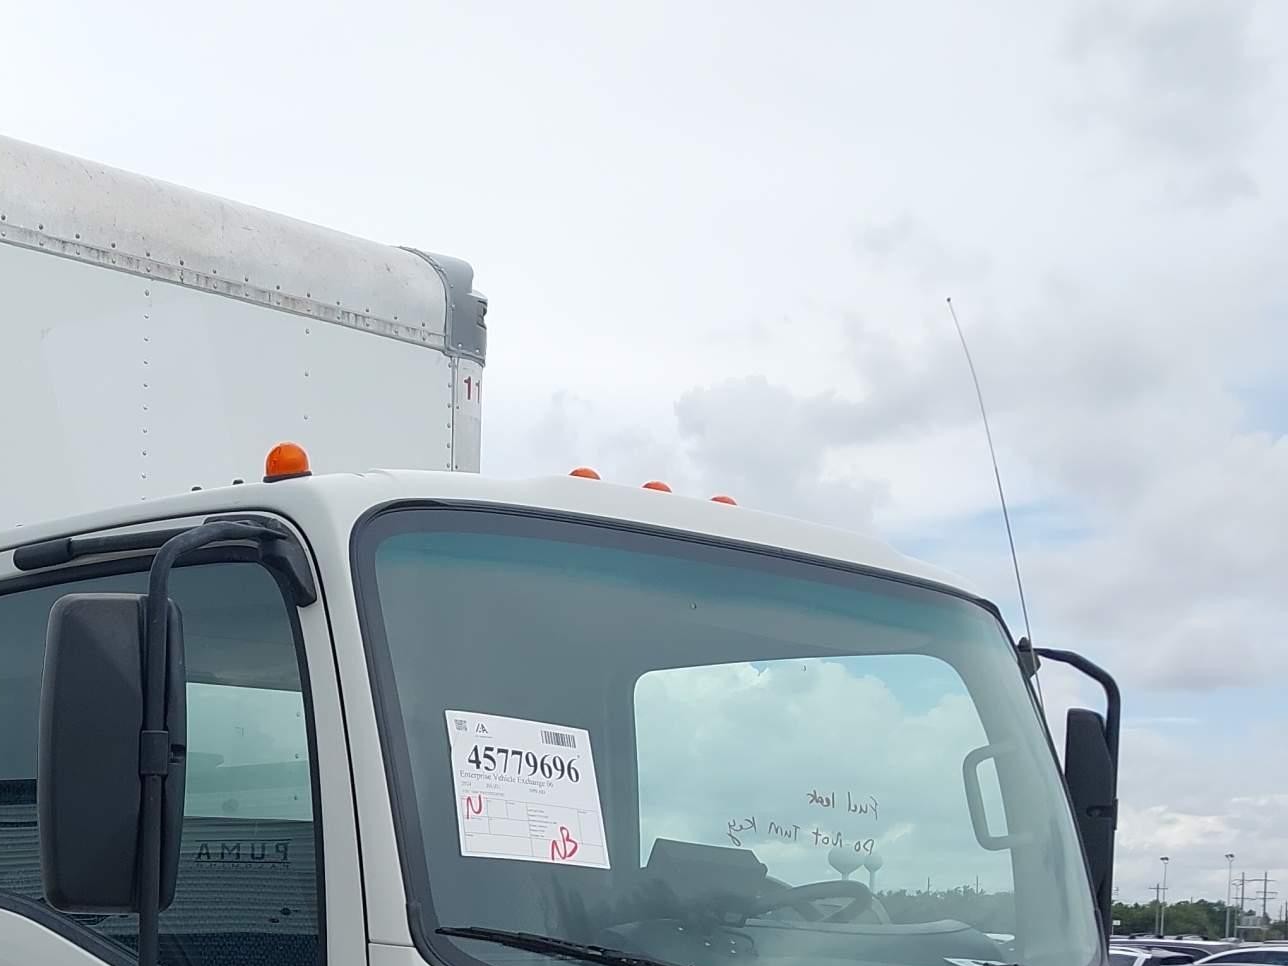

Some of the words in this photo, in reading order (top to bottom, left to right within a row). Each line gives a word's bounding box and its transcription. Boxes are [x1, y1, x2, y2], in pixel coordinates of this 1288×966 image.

[467, 744, 580, 783] 45779696
[459, 769, 492, 781] Enterprise
[492, 773, 516, 783] Vehicle
[516, 776, 545, 788] Exchange
